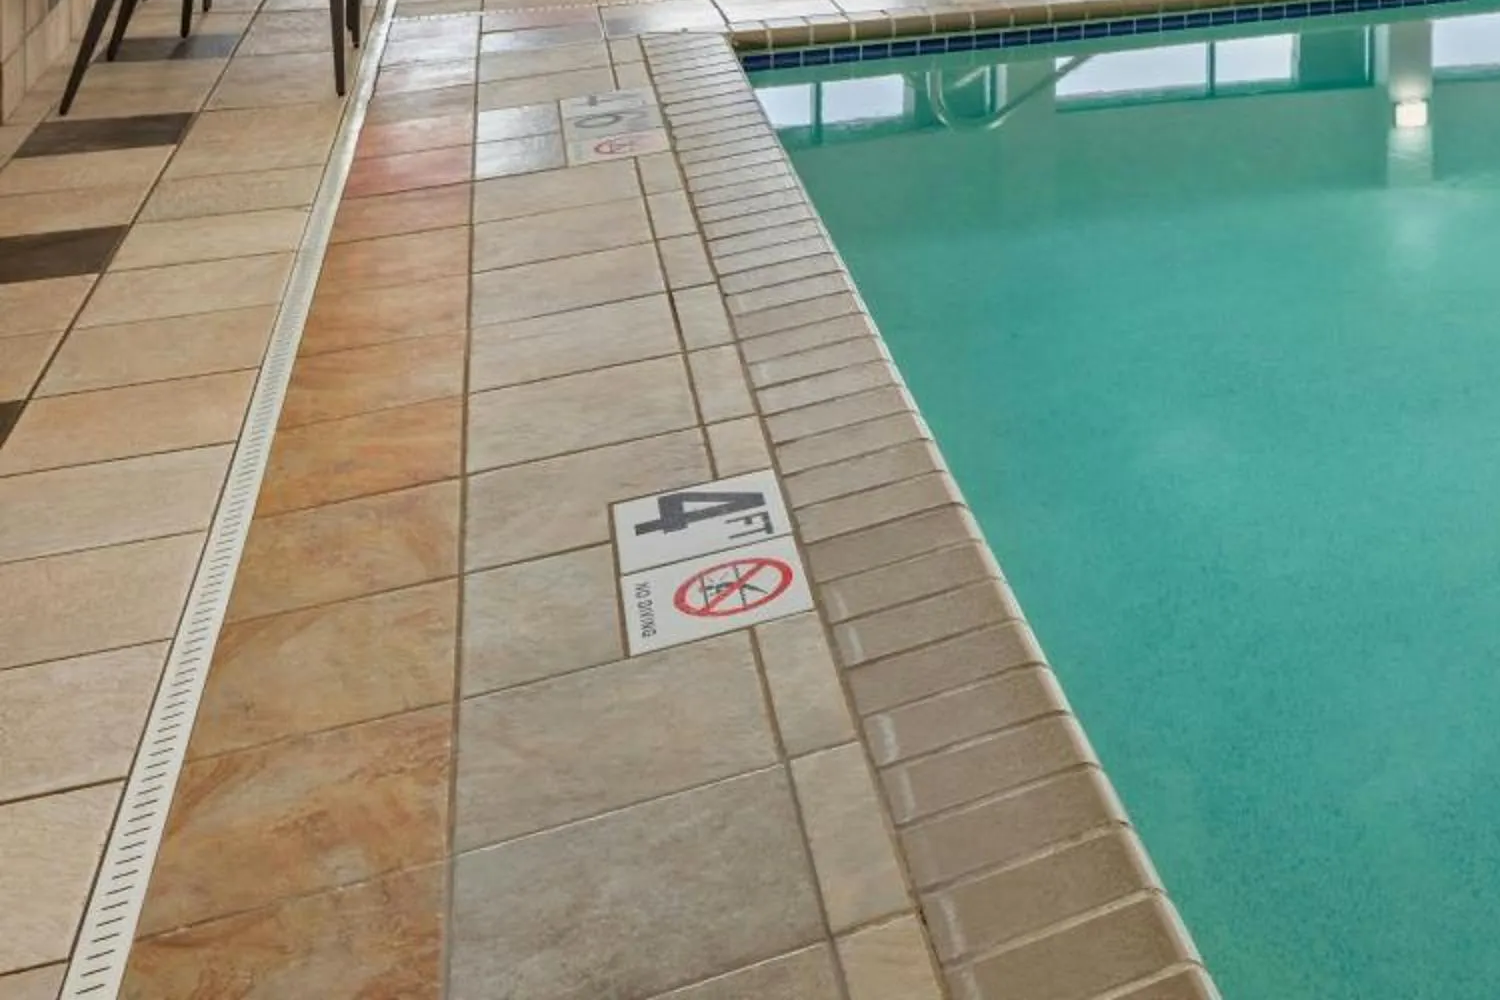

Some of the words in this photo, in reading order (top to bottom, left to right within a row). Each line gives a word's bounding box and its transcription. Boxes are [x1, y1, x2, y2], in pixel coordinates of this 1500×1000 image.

[634, 491, 767, 536] 4
[724, 511, 774, 540] FT
[635, 581, 652, 599] NO
[638, 600, 656, 638] DIVING
